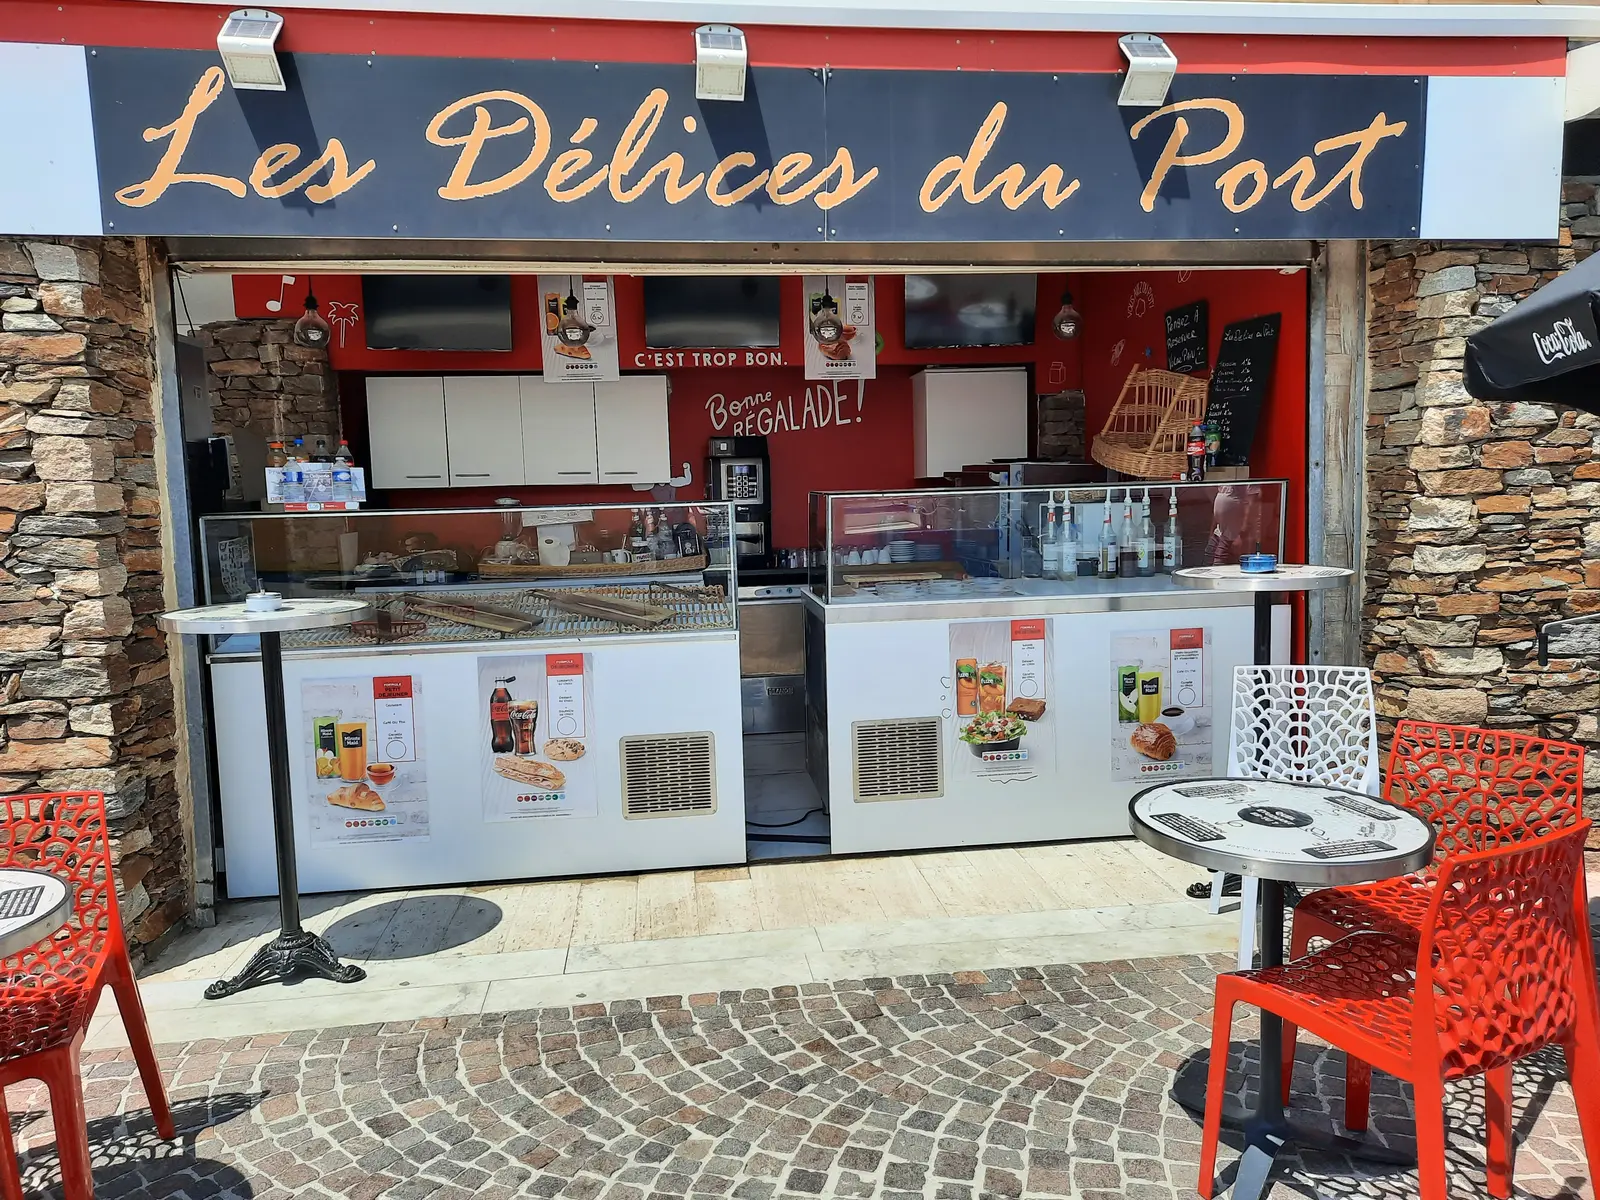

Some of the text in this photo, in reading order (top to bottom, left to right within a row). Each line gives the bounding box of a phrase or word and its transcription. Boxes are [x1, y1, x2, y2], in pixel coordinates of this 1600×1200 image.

[115, 66, 1407, 213] Les Délices du Port
[634, 352, 788, 367] C'EST TROP BON.
[705, 391, 772, 431] Bonne
